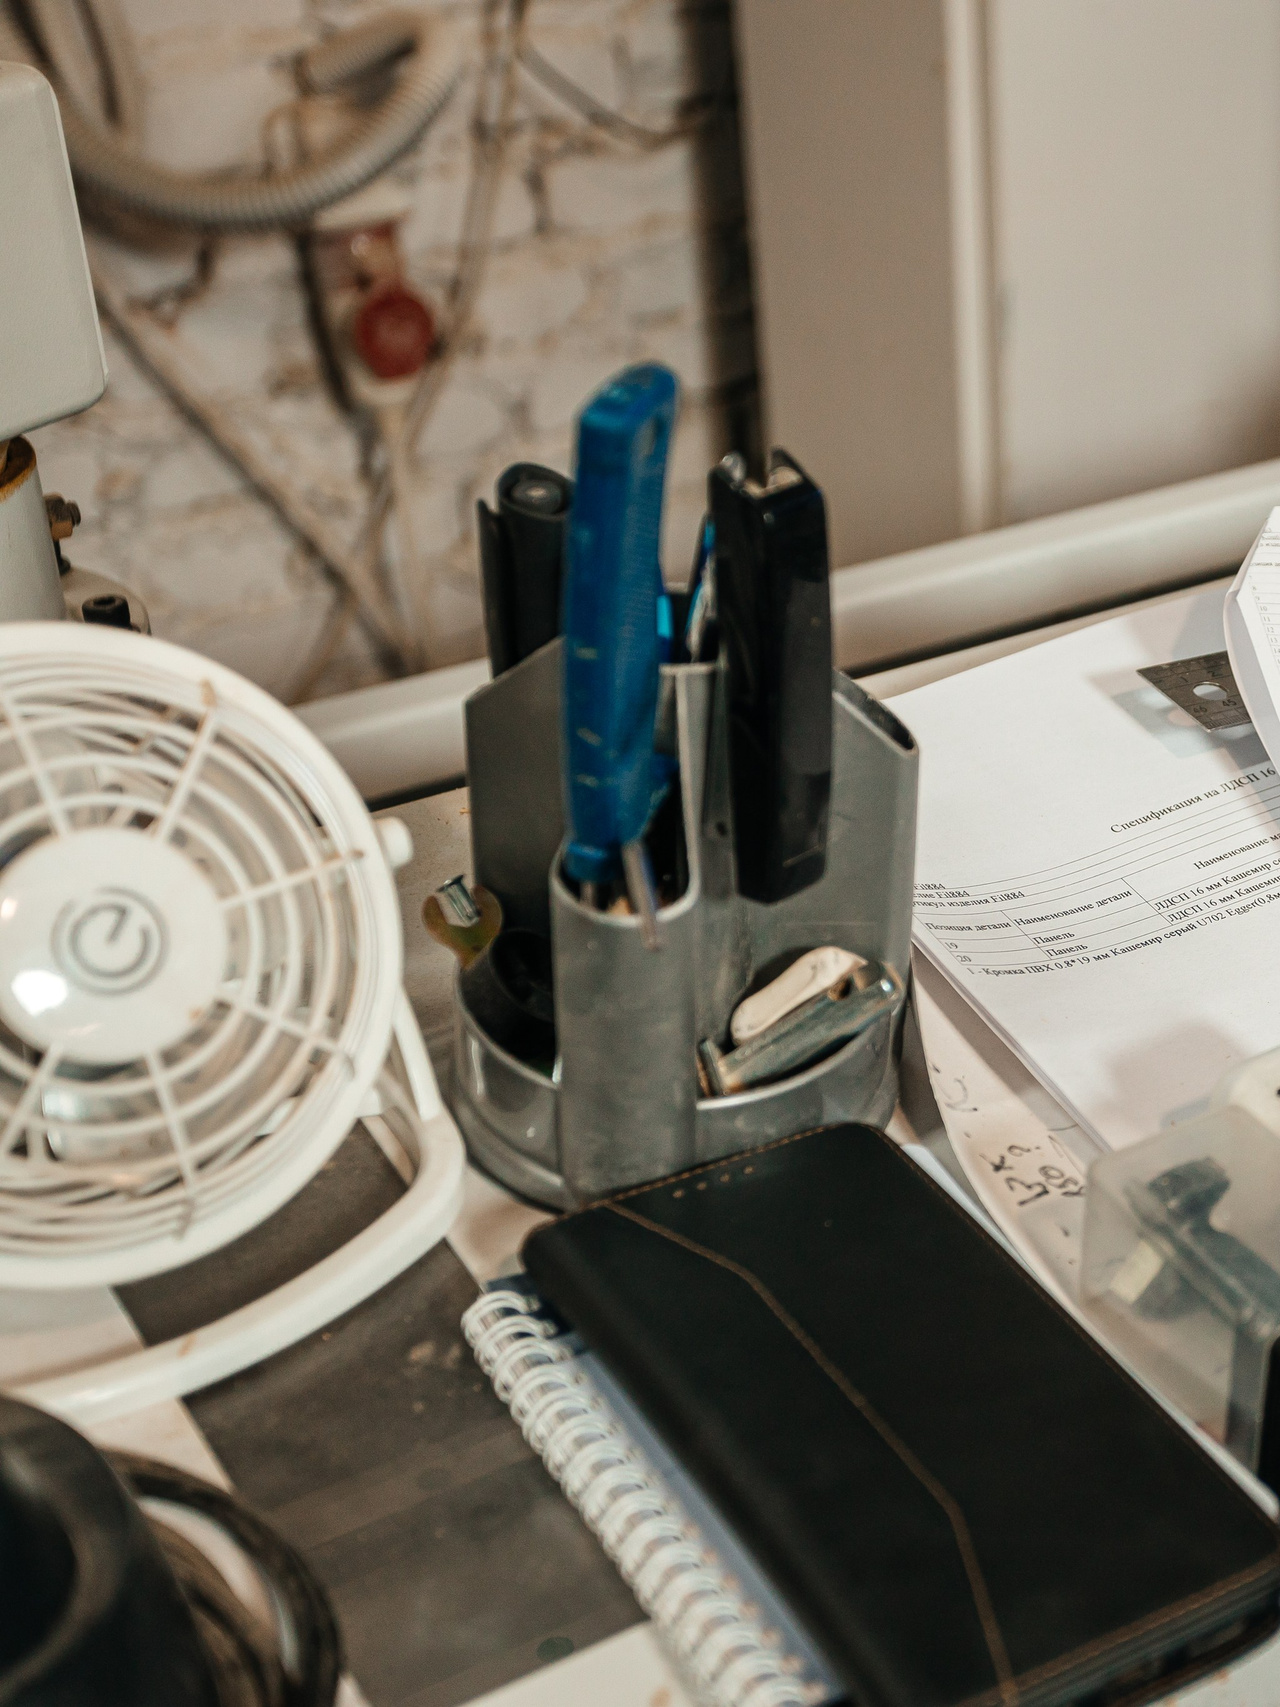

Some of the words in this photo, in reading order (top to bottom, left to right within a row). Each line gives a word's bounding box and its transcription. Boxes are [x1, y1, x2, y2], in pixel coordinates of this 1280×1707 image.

[1111, 794, 1203, 834] Спецификация
[1203, 788, 1221, 800] на
[1221, 773, 1260, 794] ЛДСП
[1260, 767, 1276, 778] 16
[925, 921, 973, 931] Позиция
[975, 921, 1012, 932] детали
[1014, 902, 1095, 926] Наименование
[1096, 889, 1132, 908] детали
[1193, 838, 1270, 870] Наименование
[945, 941, 958, 950] 19
[1033, 931, 1075, 945] Панель
[1155, 893, 1190, 911] ЛДСП
[1191, 887, 1204, 899] 16
[1205, 882, 1222, 893] мм
[1222, 862, 1272, 886] Кашемир
[949, 899, 990, 908] изделия
[990, 891, 1025, 903] Fil884
[956, 955, 972, 963] 20
[1046, 943, 1088, 957] Панель
[1168, 905, 1203, 923] ЛДСП
[1203, 899, 1217, 910] 16
[1218, 894, 1235, 905] мм
[985, 968, 1025, 977] Кромка
[1025, 963, 1054, 974] ПВХ
[1093, 952, 1110, 962] мм
[1110, 935, 1163, 957] Кашемир
[1163, 923, 1199, 941] серый
[1197, 912, 1227, 928] U702
